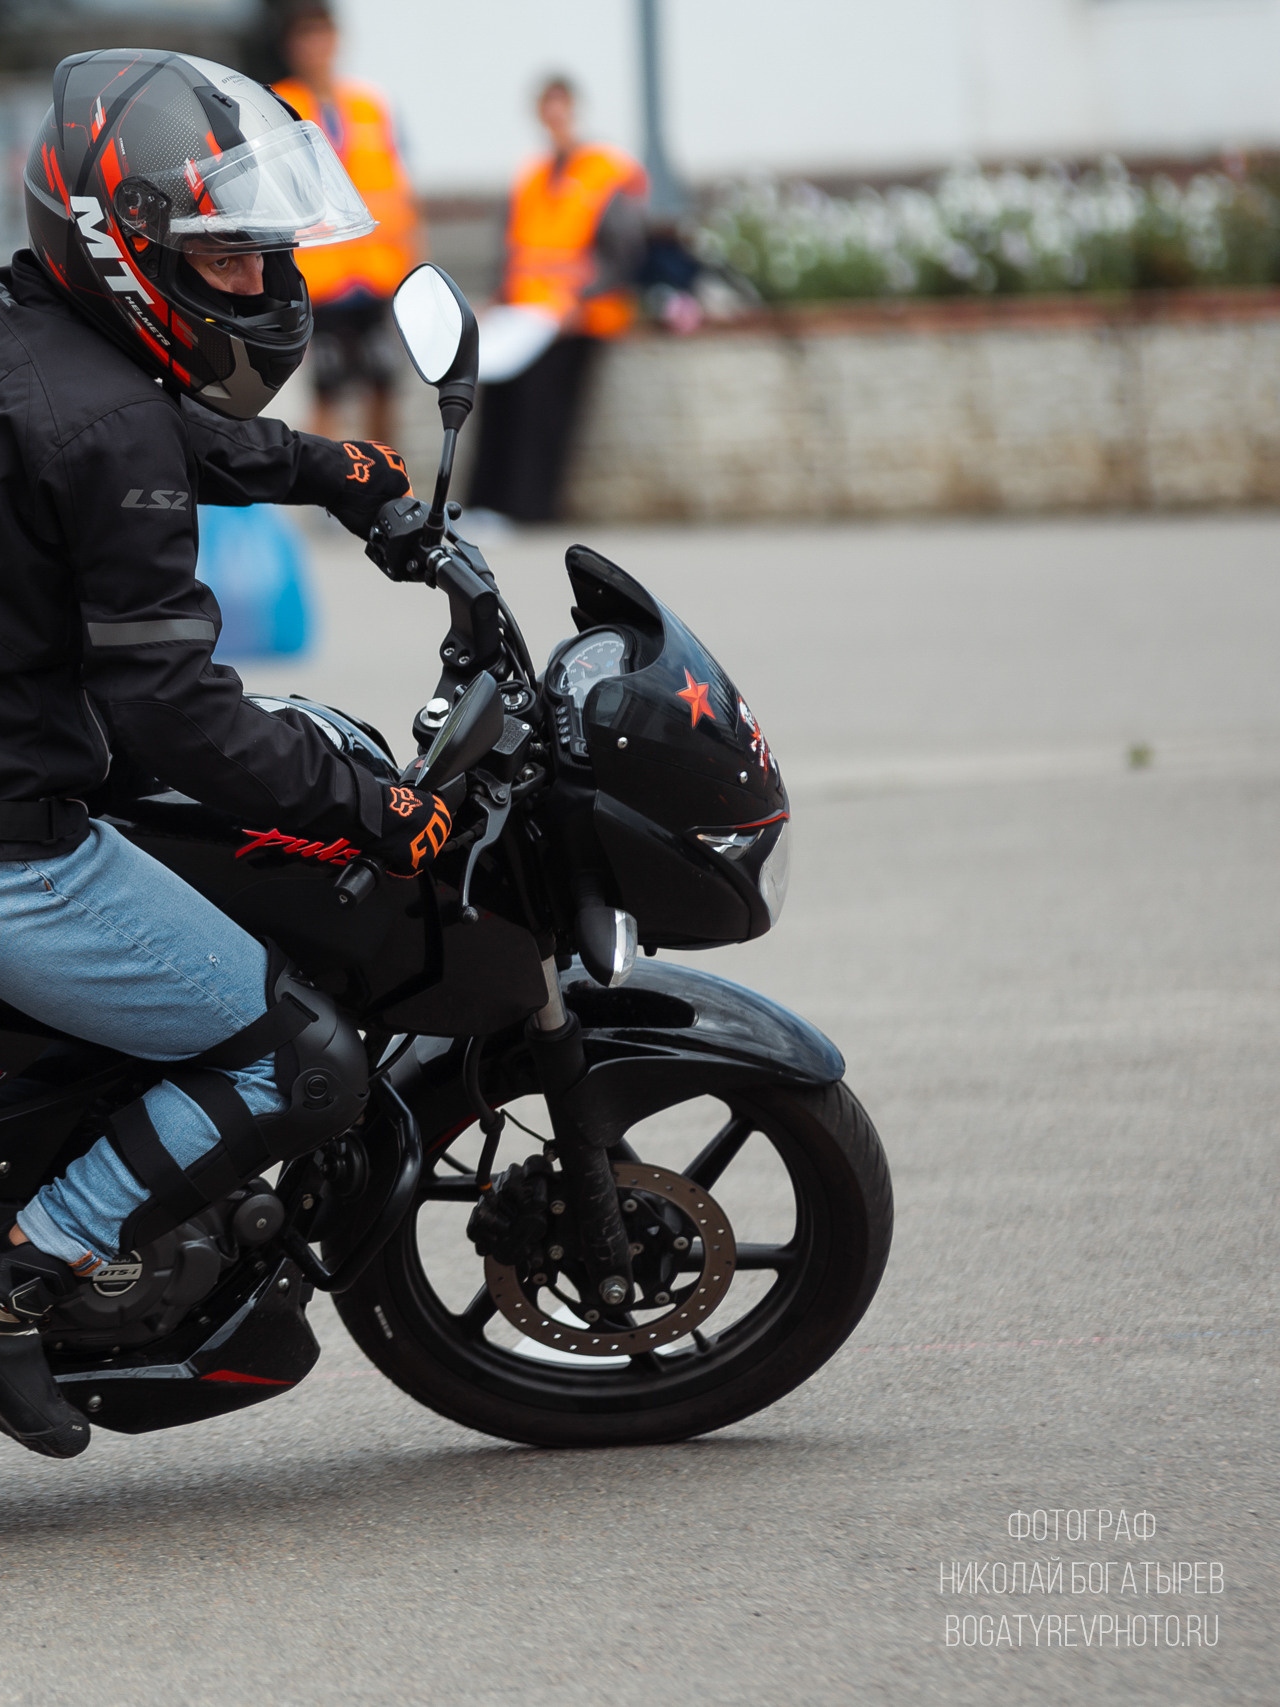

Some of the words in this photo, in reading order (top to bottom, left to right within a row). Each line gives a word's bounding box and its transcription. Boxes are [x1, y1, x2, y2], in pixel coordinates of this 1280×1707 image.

[70, 195, 155, 305] MT
[125, 296, 171, 347] HELMETS
[121, 489, 189, 511] LS2
[235, 828, 361, 866] Puls
